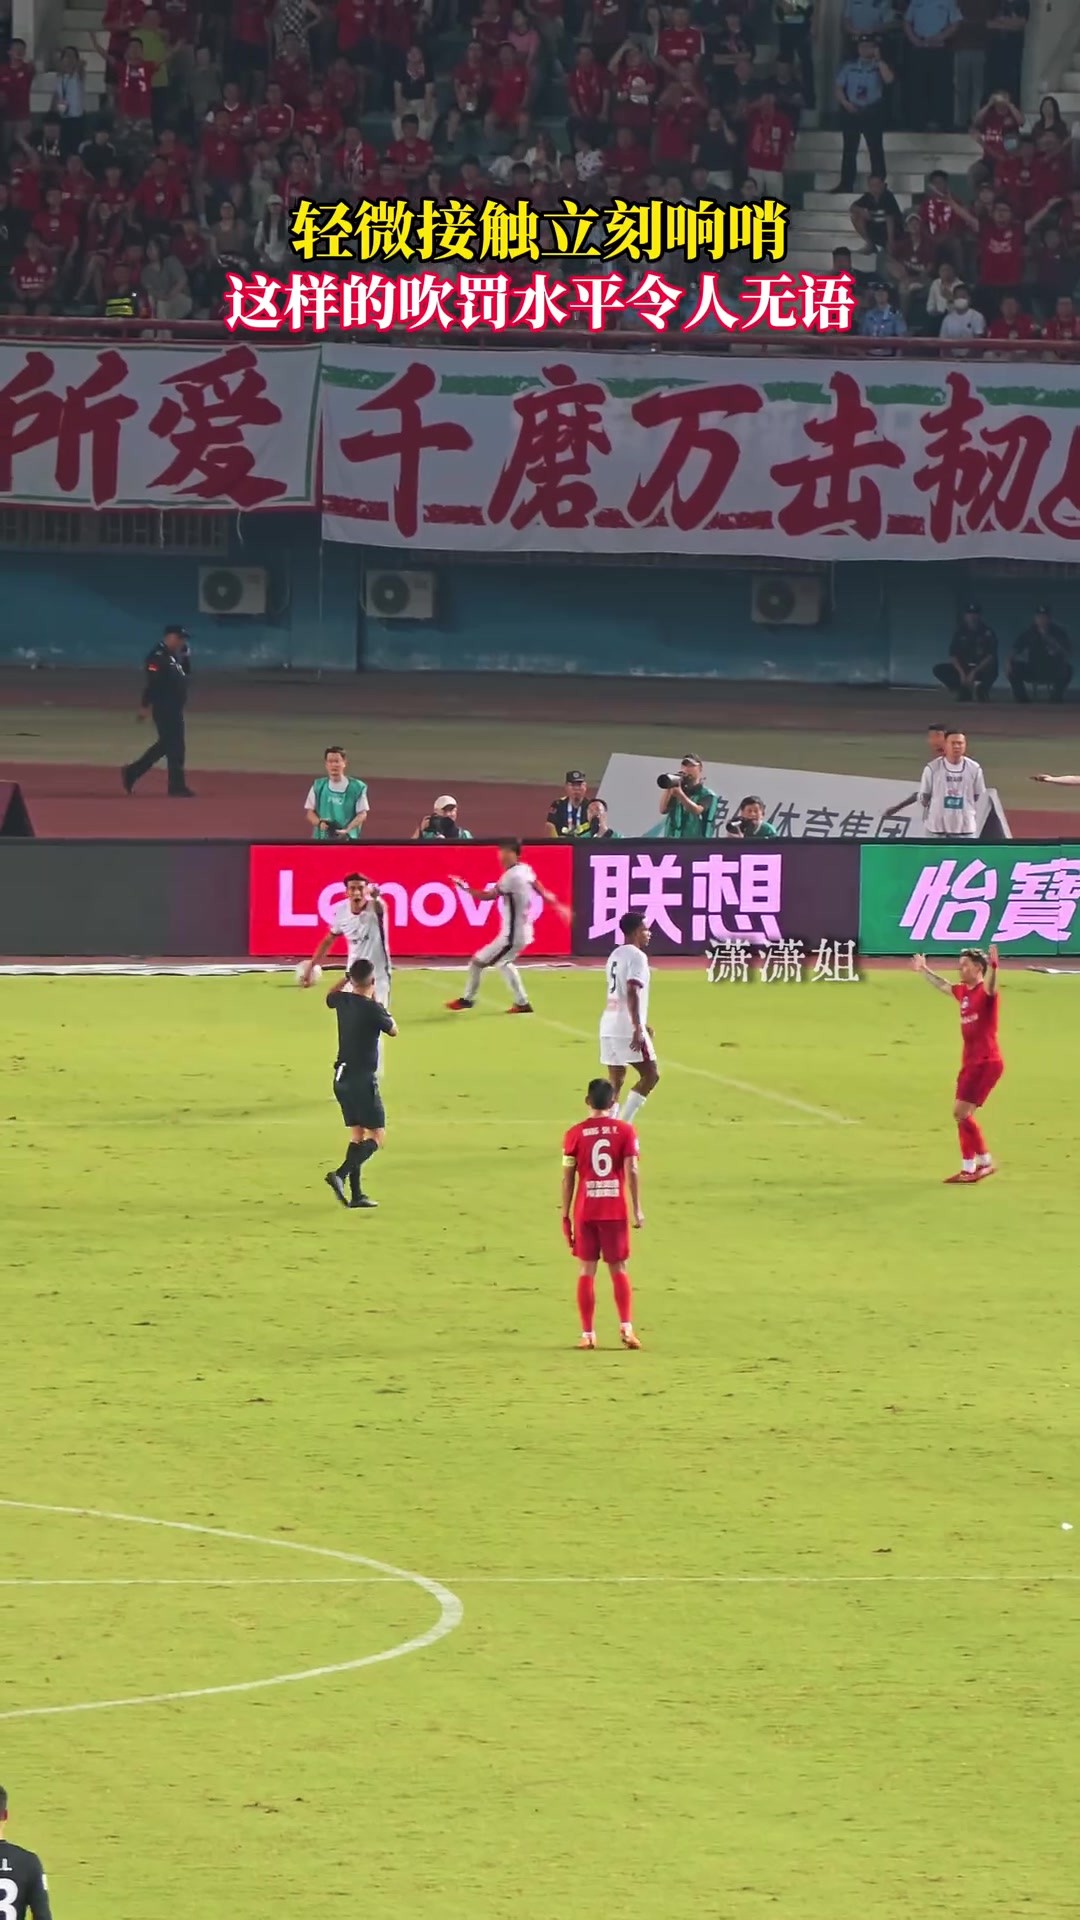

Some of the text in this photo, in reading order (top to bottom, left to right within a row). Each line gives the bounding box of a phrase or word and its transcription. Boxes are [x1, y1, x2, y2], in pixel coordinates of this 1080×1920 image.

[0, 346, 288, 507] 所爱
[588, 854, 782, 945] 联想
[610, 961, 618, 994] 5
[592, 1138, 613, 1177] 6
